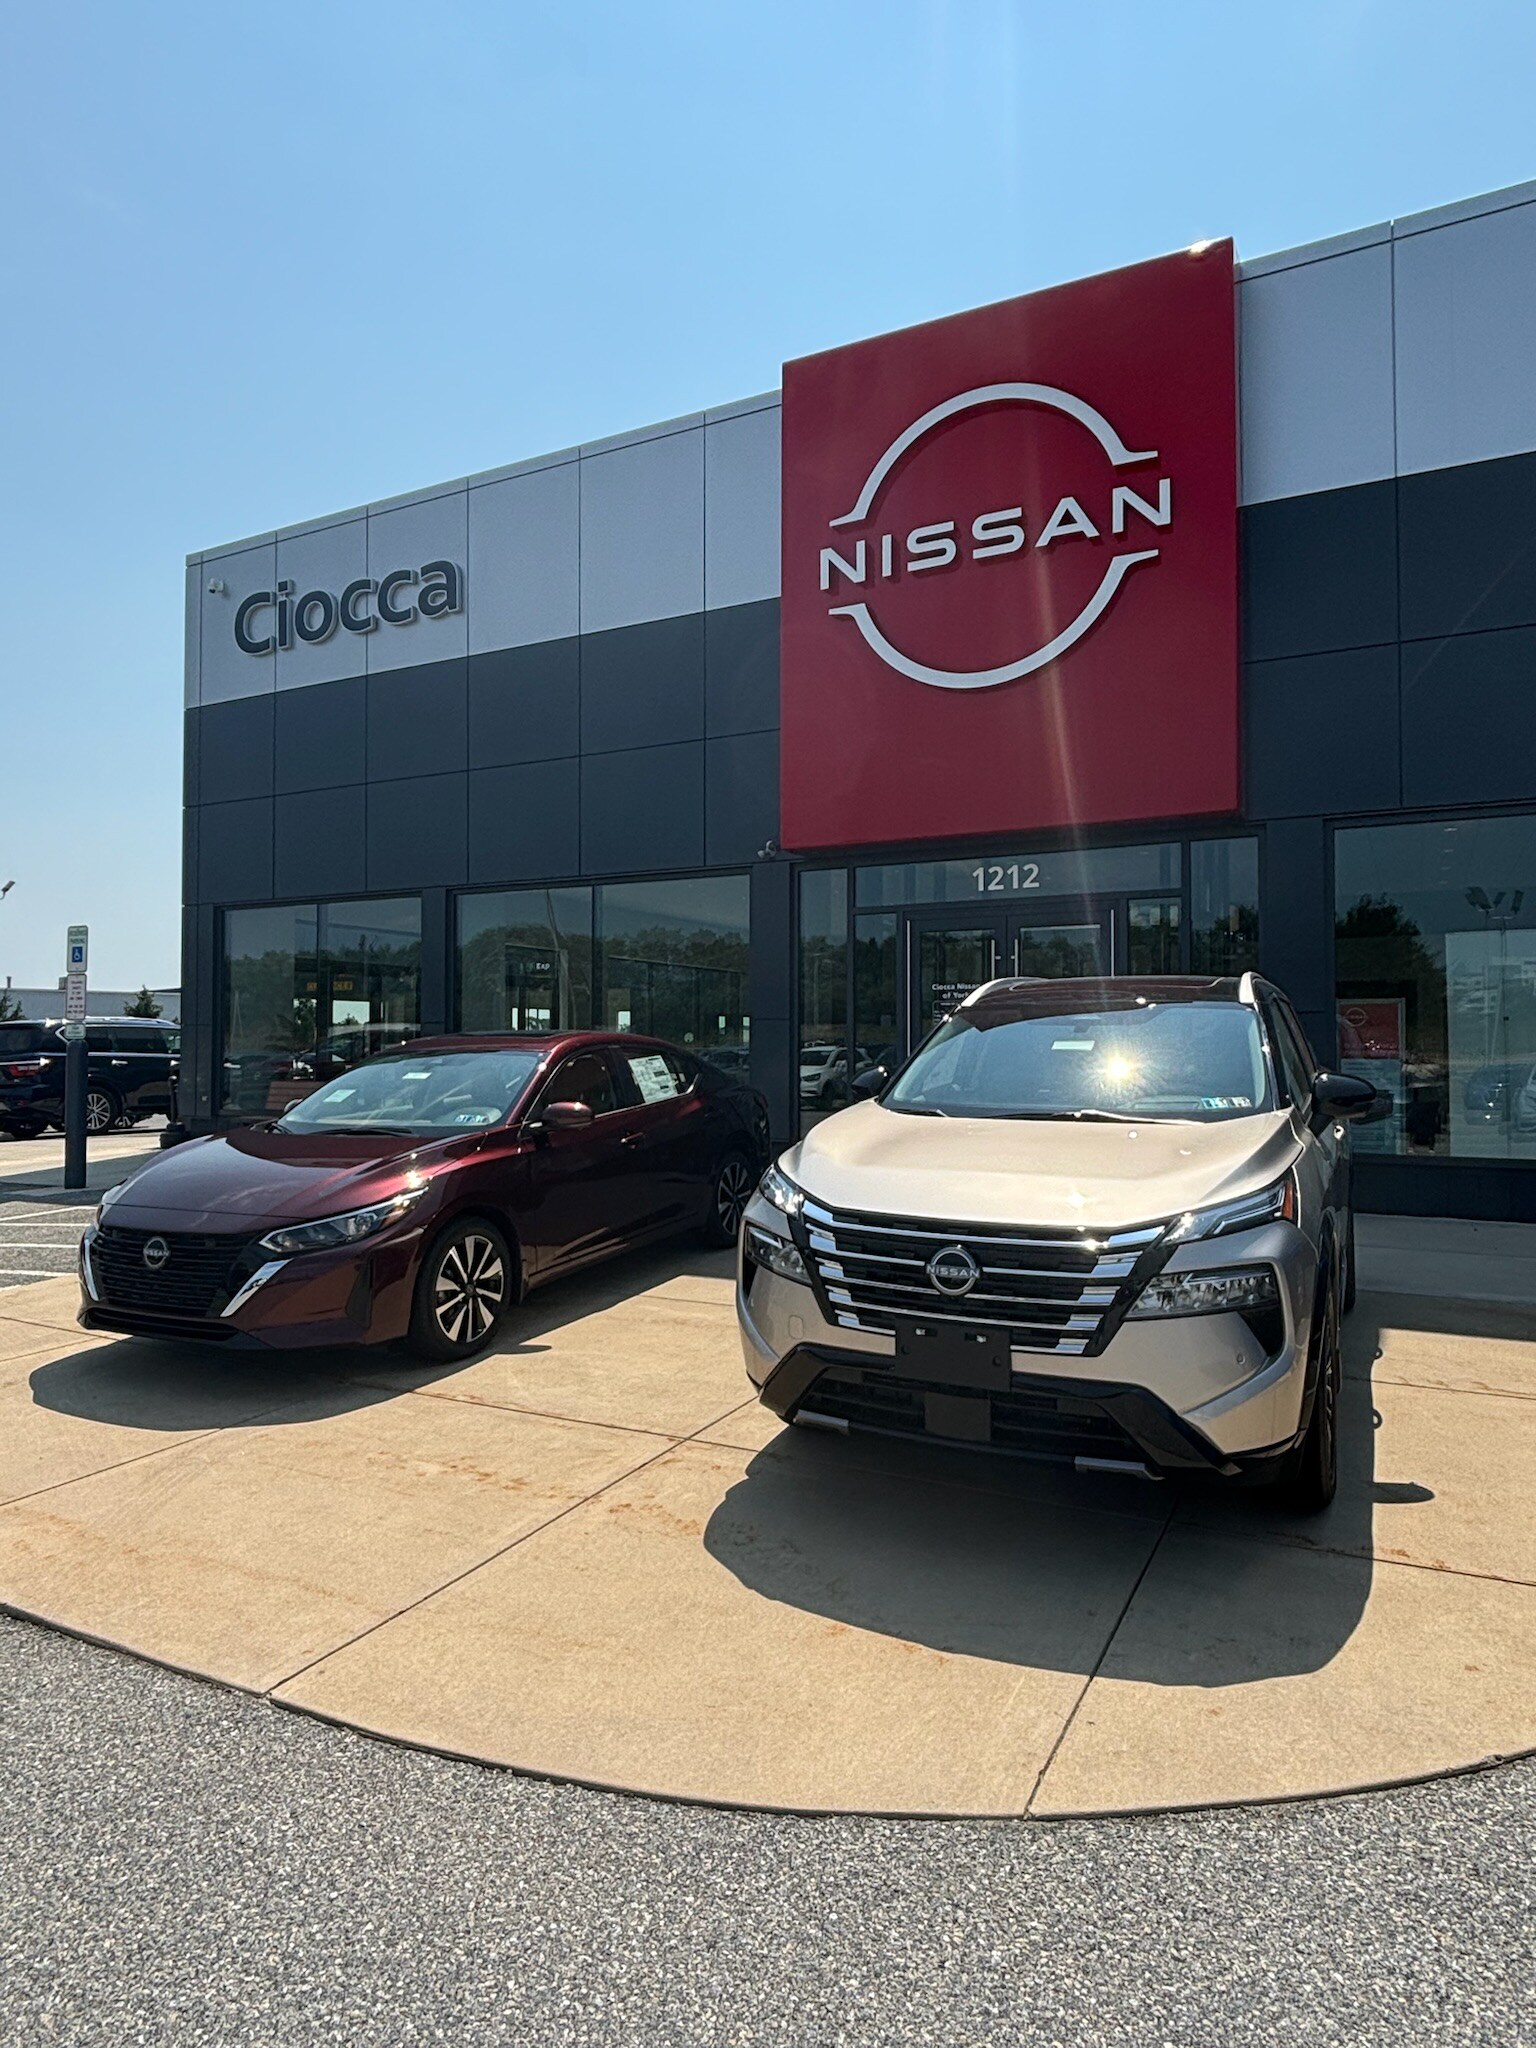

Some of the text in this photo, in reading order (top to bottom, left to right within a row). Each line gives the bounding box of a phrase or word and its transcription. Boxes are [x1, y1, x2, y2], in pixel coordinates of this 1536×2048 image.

[819, 478, 1172, 591] NISSAN
[234, 559, 462, 655] Ciocca
[973, 863, 1040, 892] 1212
[931, 983, 956, 991] Ciocca
[942, 991, 951, 999] of
[143, 1248, 169, 1256] NISSAN
[926, 1264, 980, 1277] NISSAN
